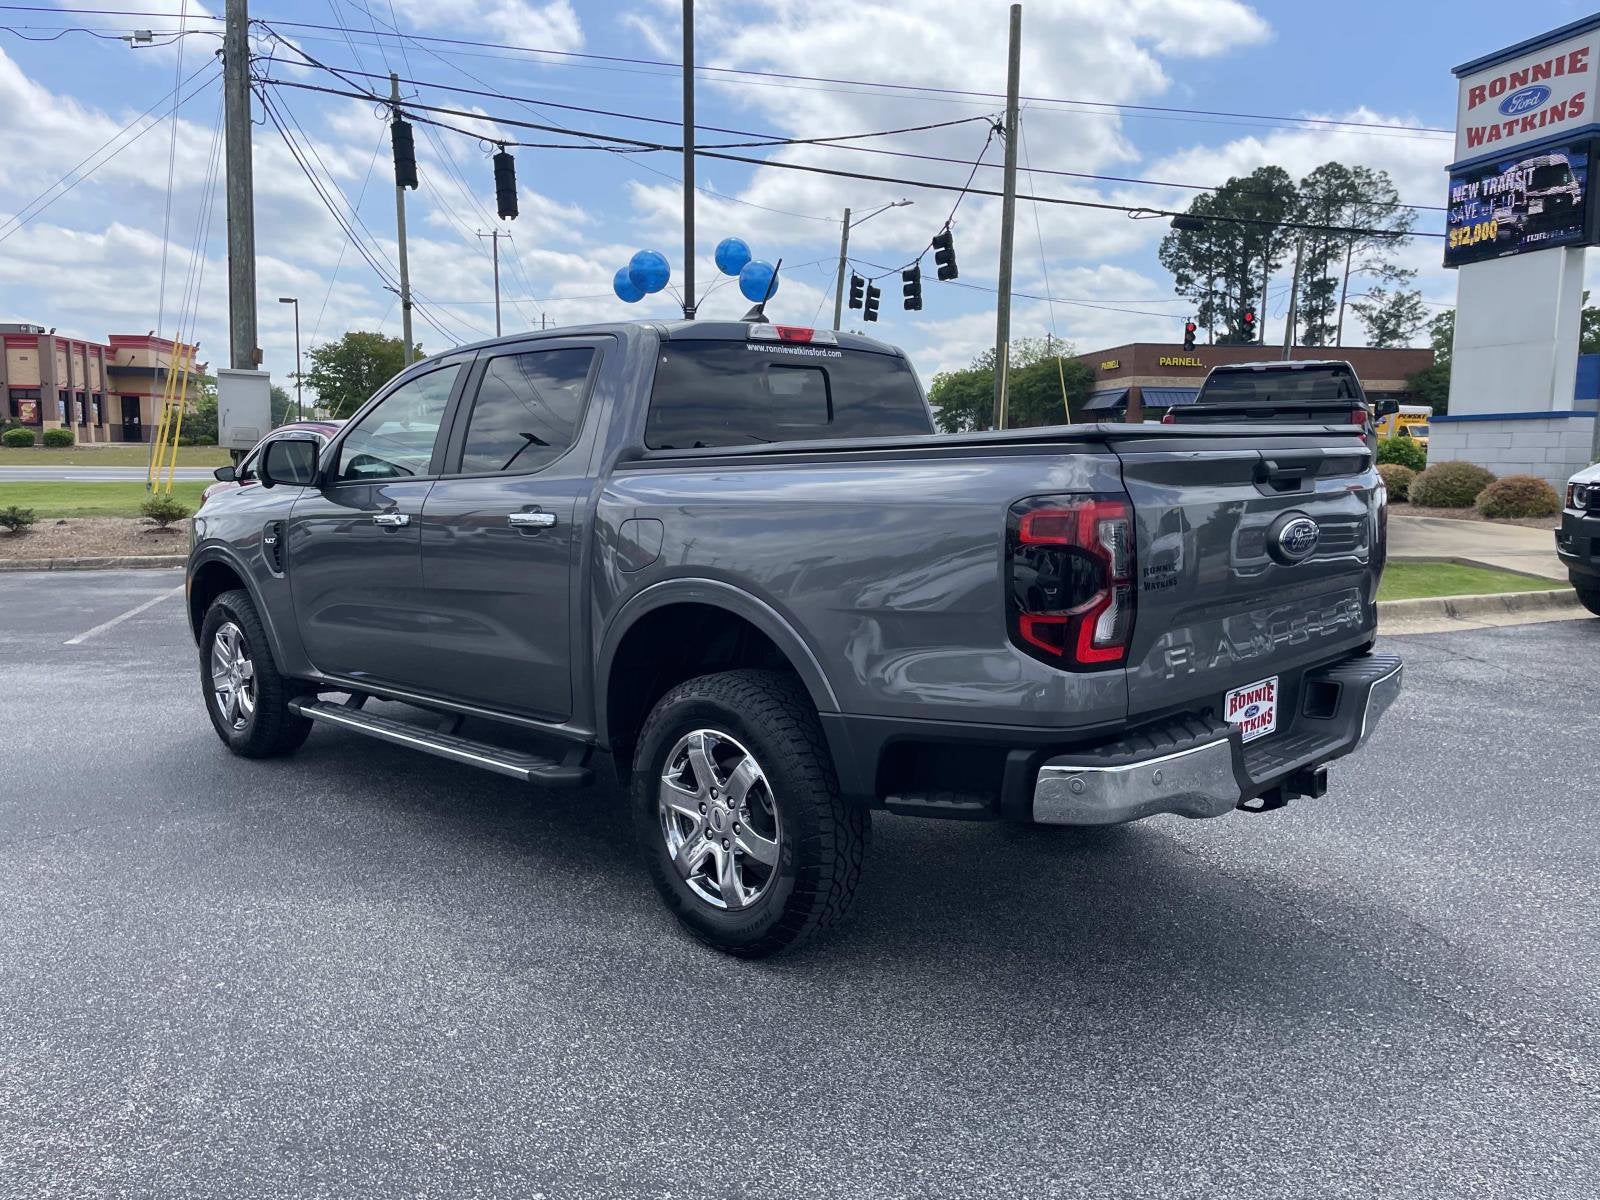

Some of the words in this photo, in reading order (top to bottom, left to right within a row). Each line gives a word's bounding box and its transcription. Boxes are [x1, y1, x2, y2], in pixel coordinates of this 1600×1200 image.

[1467, 46, 1590, 111] RONNIE
[1466, 91, 1586, 149] WATKINS
[1452, 181, 1480, 203] NEW
[1482, 166, 1536, 196] TRANSIT
[1451, 202, 1481, 224] SAVE
[746, 343, 842, 358] www.ronniewatkinsford.com
[1159, 356, 1203, 367] PARNELL
[1100, 359, 1120, 371] PARNELL
[1292, 527, 1317, 549] Ford
[1143, 563, 1178, 578] RONNIE
[1143, 578, 1178, 592] WATKINS
[1164, 597, 1364, 679] RANGER
[1229, 684, 1275, 717] RONNIE
[1237, 706, 1273, 735] ATKINS
